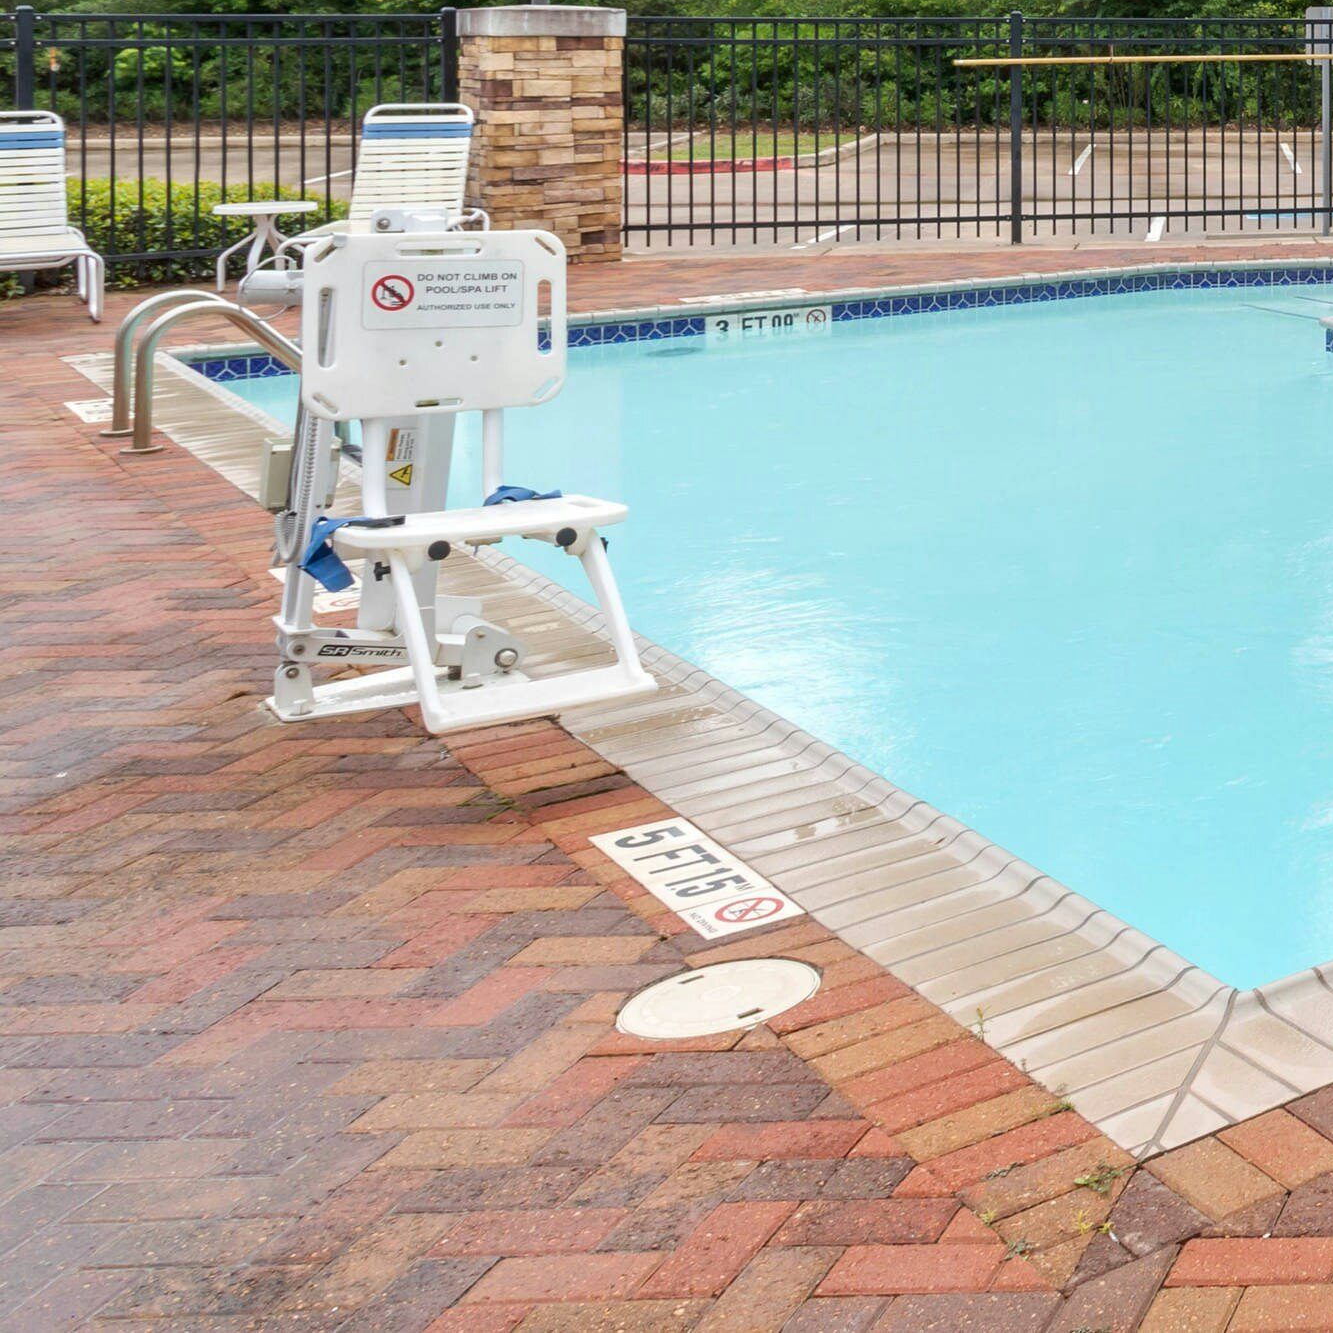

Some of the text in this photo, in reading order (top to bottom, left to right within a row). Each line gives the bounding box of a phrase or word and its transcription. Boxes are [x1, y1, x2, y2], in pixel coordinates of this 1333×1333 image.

[417, 272, 517, 282] DO NOT CLIMB ON
[426, 285, 508, 294] POOL/SPA LIFT
[494, 302, 516, 310] ONLY
[715, 319, 729, 332] 3
[742, 316, 766, 331] FT
[320, 646, 401, 657] SR Smith
[614, 826, 686, 849] 5
[633, 844, 721, 875] FT
